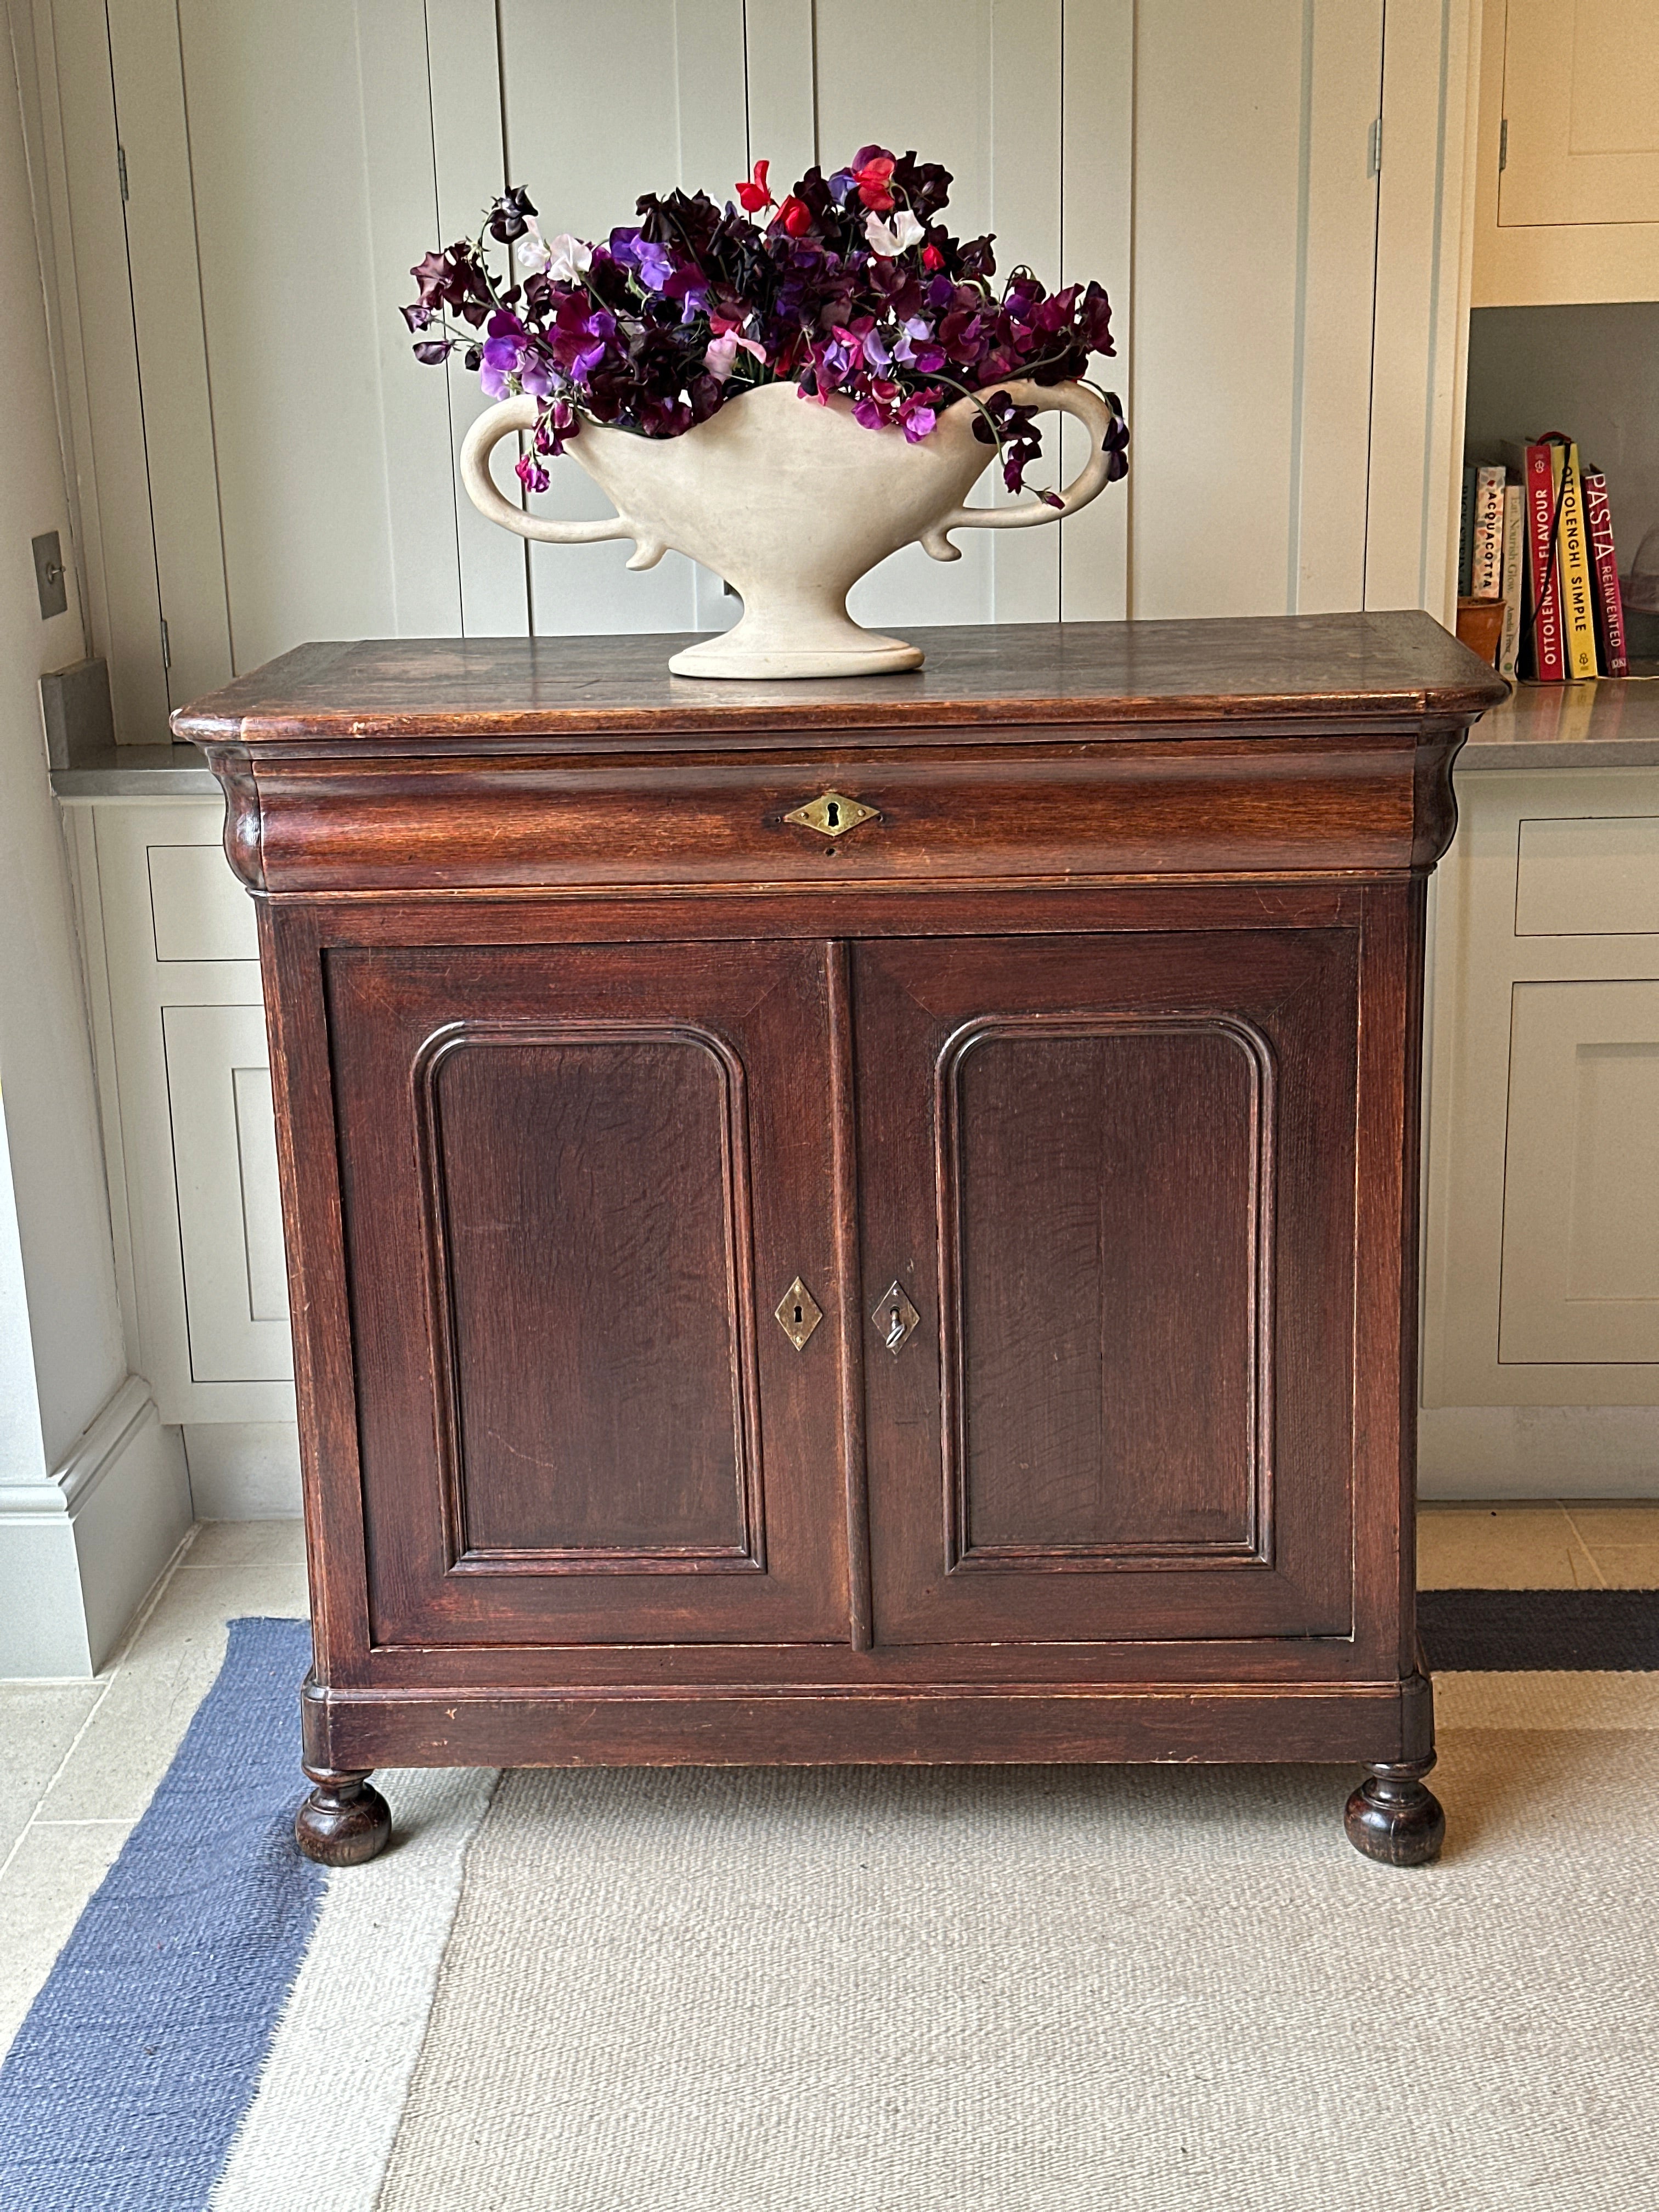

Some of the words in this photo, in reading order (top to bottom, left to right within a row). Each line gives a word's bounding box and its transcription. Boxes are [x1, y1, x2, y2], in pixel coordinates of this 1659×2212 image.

[1483, 492, 1497, 588] ACQUACOTTA
[1536, 488, 1550, 559] FLAVOUR
[1563, 466, 1582, 569] OTTOLENGHI
[1585, 473, 1615, 561] PASTA
[1601, 566, 1621, 647] REINVENTED
[1571, 576, 1586, 633] SIMPLE
